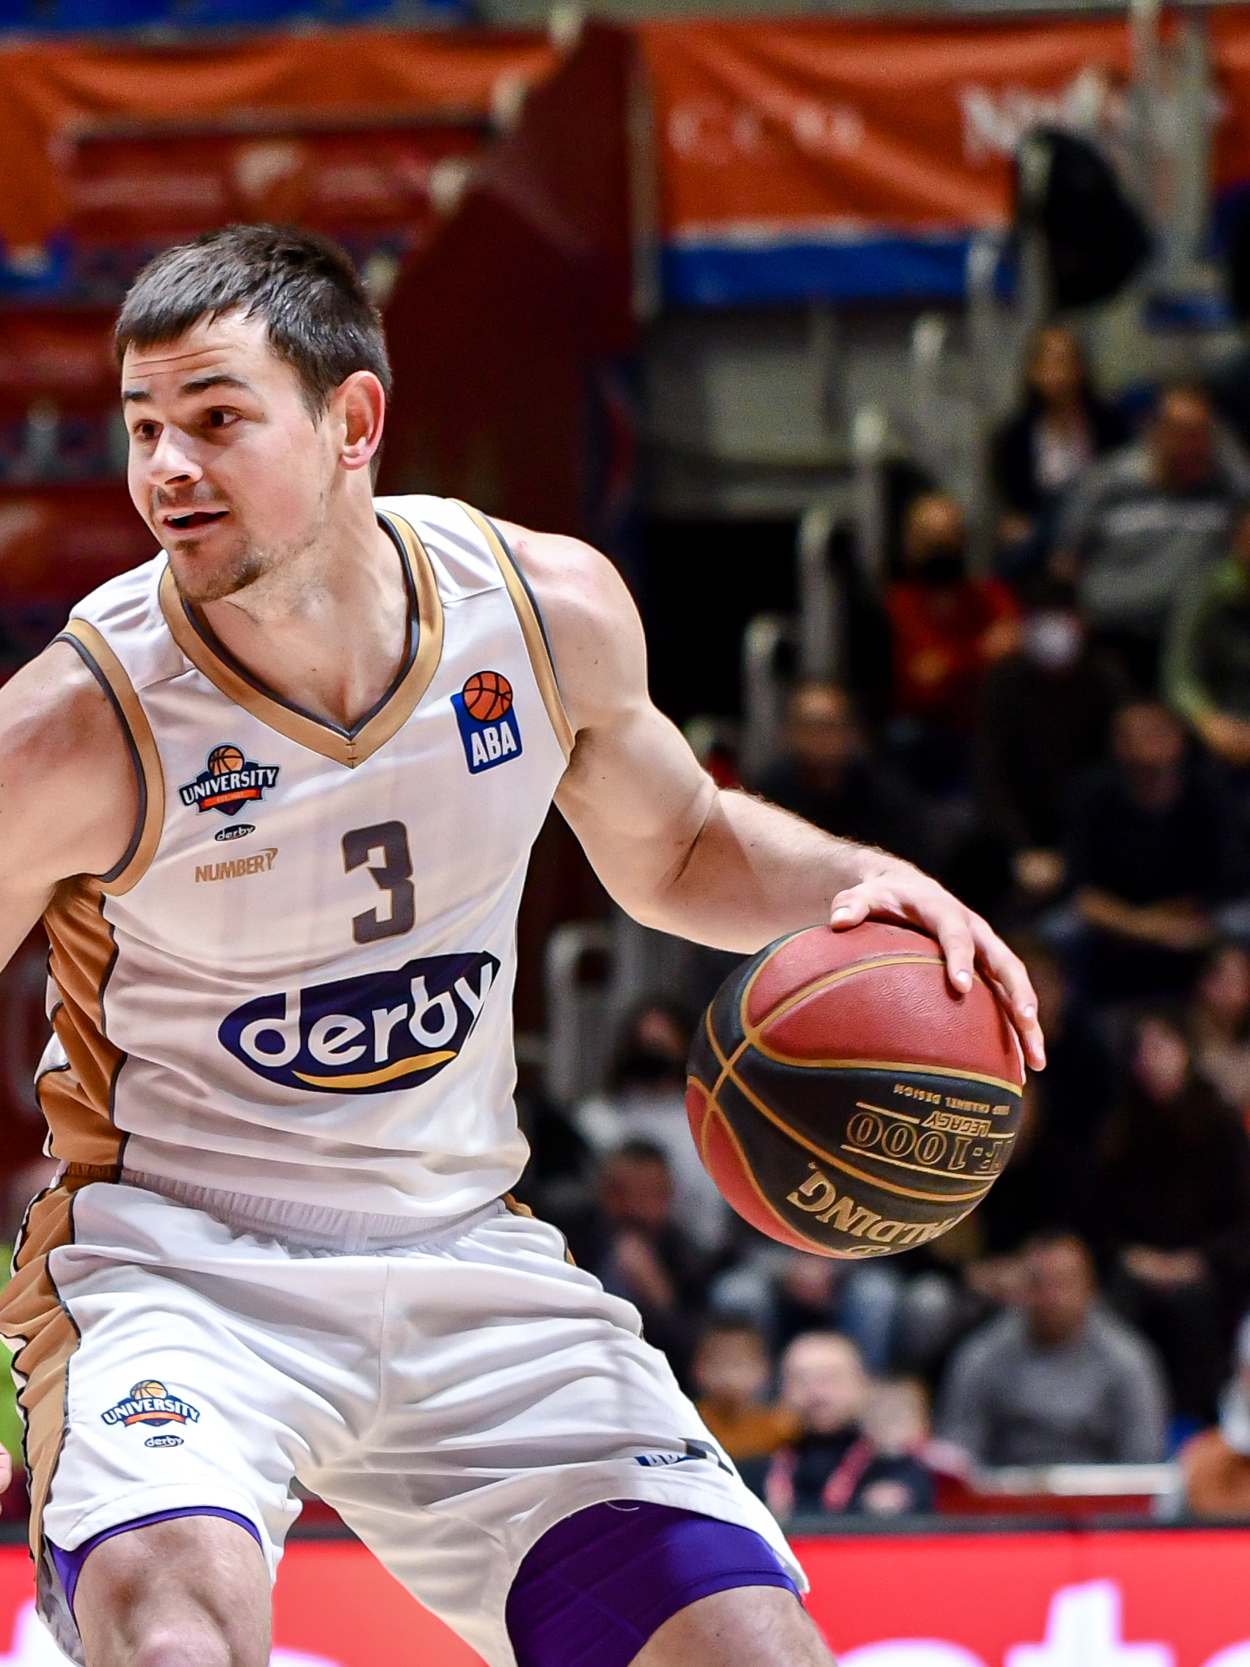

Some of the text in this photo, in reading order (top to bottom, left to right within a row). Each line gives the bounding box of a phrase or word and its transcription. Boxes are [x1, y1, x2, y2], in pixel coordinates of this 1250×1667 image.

[469, 721, 517, 767] ABA
[182, 769, 277, 804] UNIVERSITY
[216, 826, 254, 841] derby
[341, 820, 415, 944] 3
[239, 962, 493, 1067] derby
[892, 1083, 942, 1105] DESIGN
[944, 1096, 991, 1114] CHANNEL
[921, 1110, 992, 1137] LEGACY
[786, 1171, 962, 1243] ALDING
[103, 1398, 198, 1423] UNIVERSITY
[146, 1436, 183, 1447] derby
